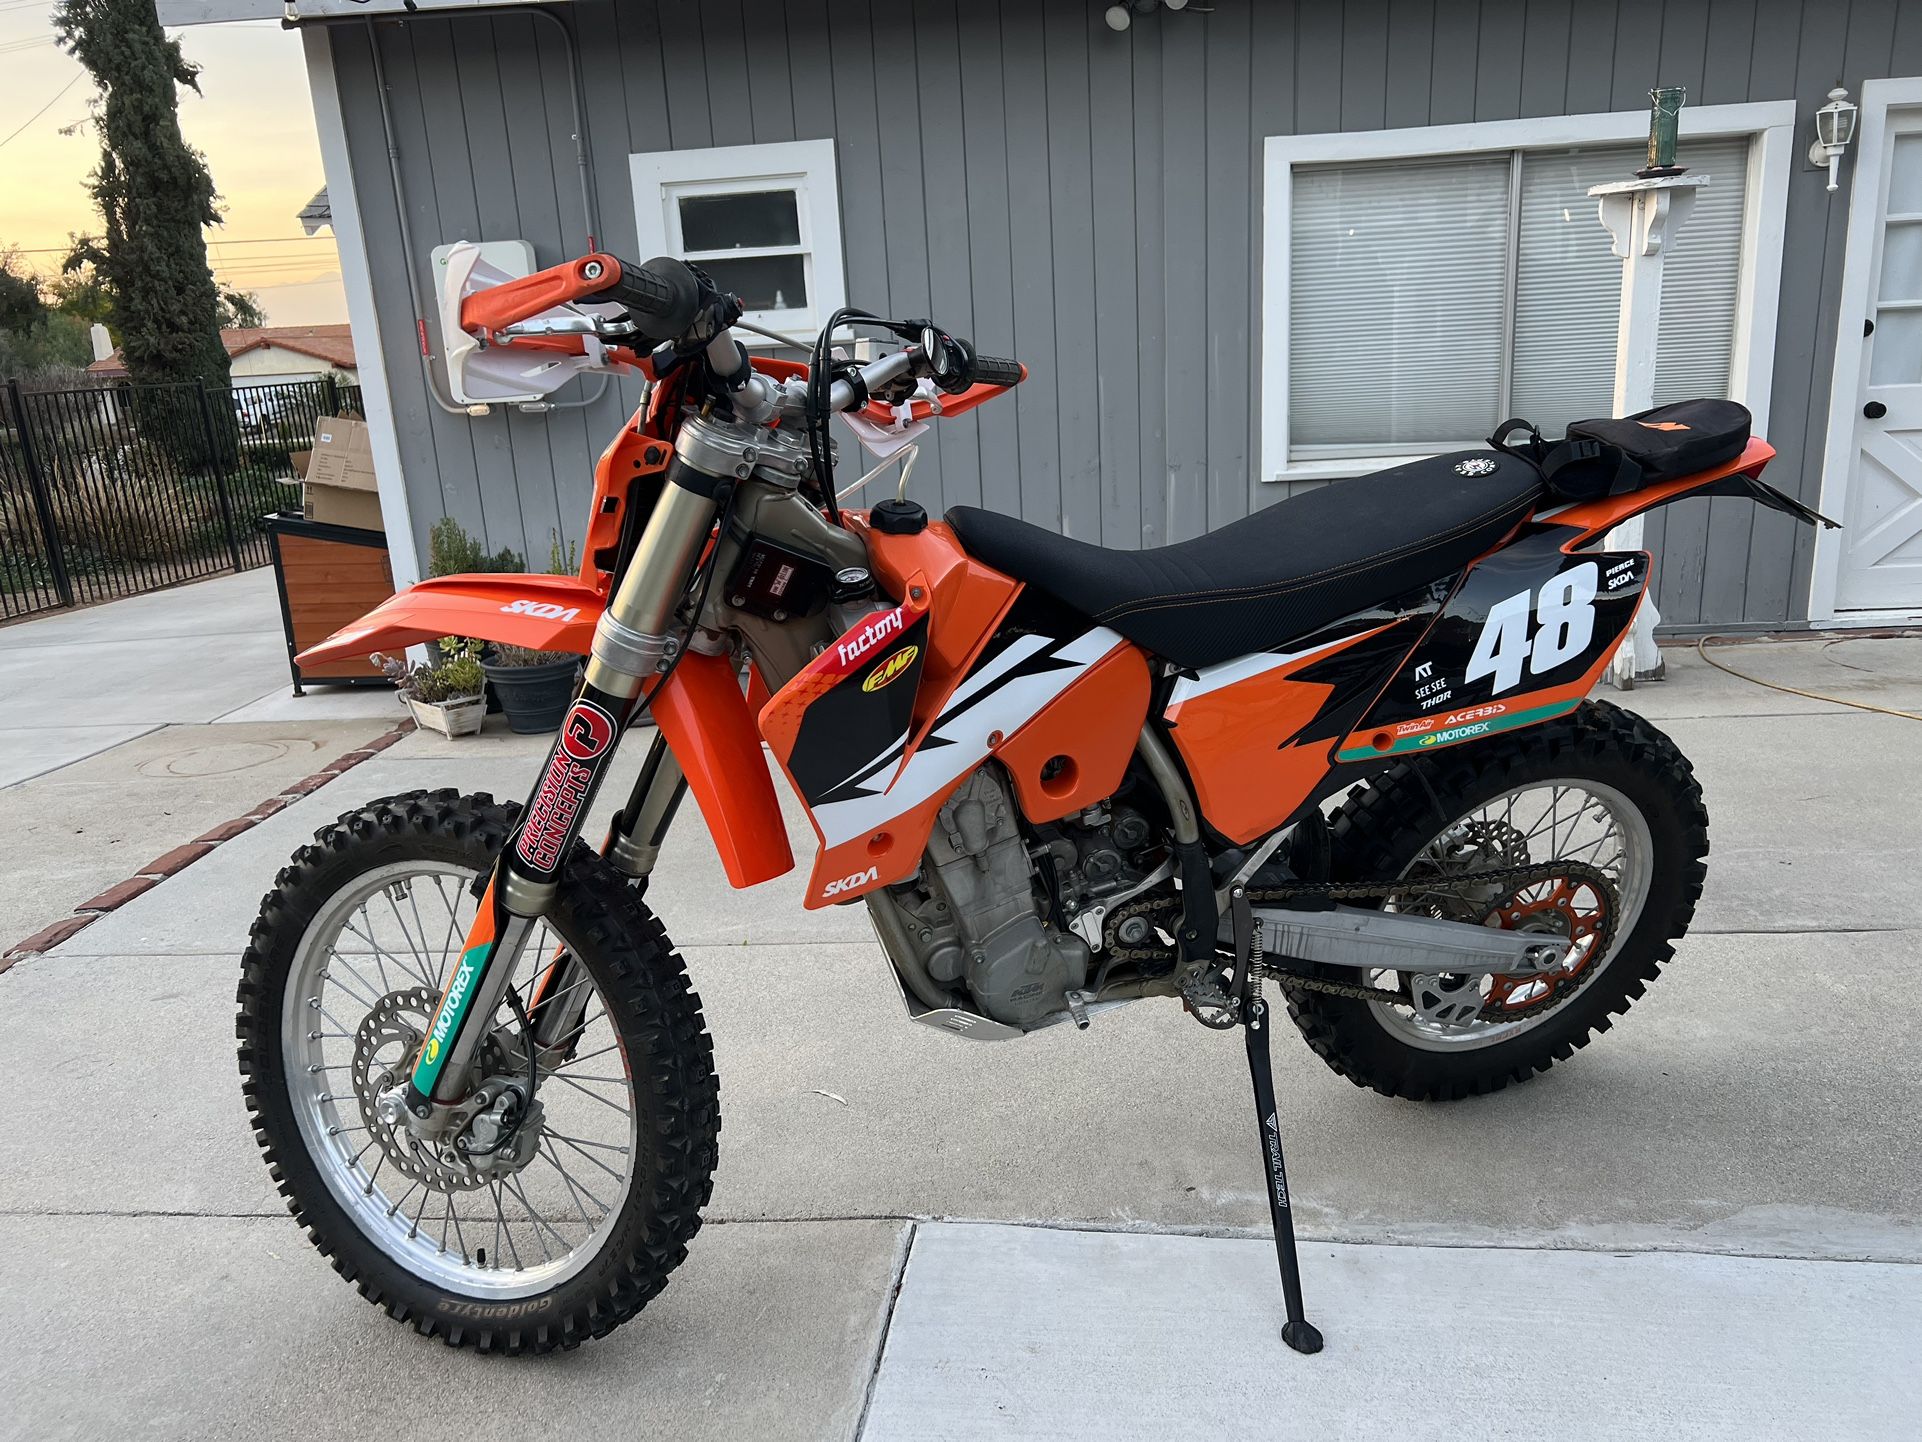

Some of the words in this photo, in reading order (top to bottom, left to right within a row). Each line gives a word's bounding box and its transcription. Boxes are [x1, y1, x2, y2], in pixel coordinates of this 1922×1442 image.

[1605, 558, 1635, 577] PIERCE
[1608, 570, 1635, 590] SKDA
[499, 599, 581, 622] SKDA
[837, 607, 904, 667] factory
[1464, 561, 1598, 696] 48
[865, 647, 917, 691] FMF
[1415, 684, 1431, 700] SEE
[1430, 677, 1447, 692] SEE
[1420, 690, 1452, 710] THOR
[1436, 723, 1489, 743] MOTOREX
[518, 748, 572, 861] PRECISION
[533, 762, 591, 869] CONCEPTS
[822, 866, 879, 898] SKDA
[432, 957, 475, 1043] MOTOREX
[1268, 1131, 1282, 1172] TRAIL
[1274, 1172, 1288, 1208] TECH
[437, 1296, 553, 1320] Goldentyre
